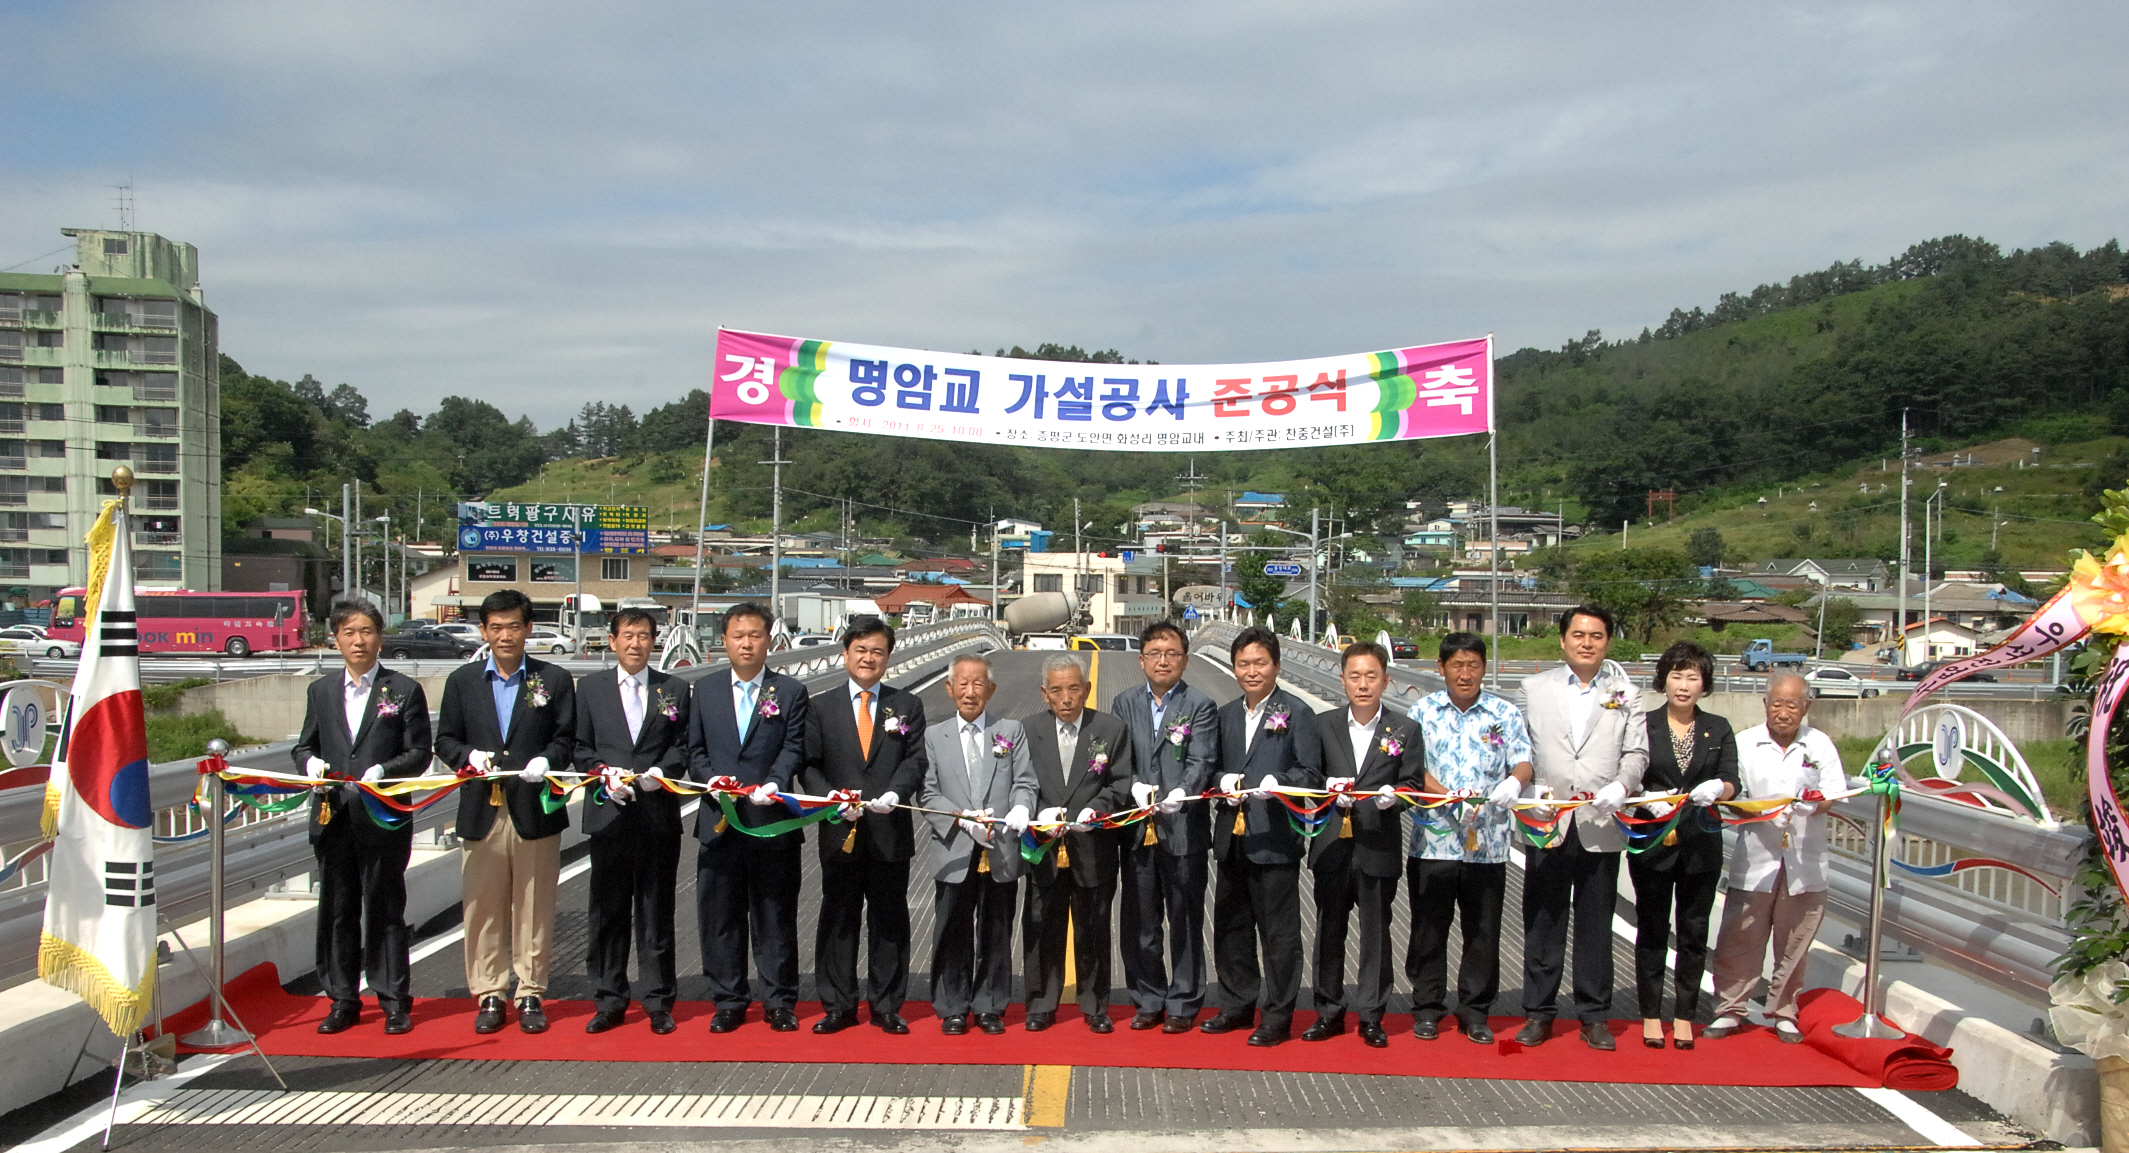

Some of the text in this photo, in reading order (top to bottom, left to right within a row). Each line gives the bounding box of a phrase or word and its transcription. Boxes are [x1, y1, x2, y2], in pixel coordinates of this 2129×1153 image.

[720, 354, 775, 405] 경
[849, 358, 1347, 422] 명암교 가설공사 준공식
[1419, 364, 1479, 415] 축
[1037, 430, 1072, 443] 증평군
[1077, 432, 1112, 445] 도안면
[1116, 432, 1152, 445] 화성리
[1157, 431, 1204, 446] 명암교내
[176, 627, 214, 644] min
